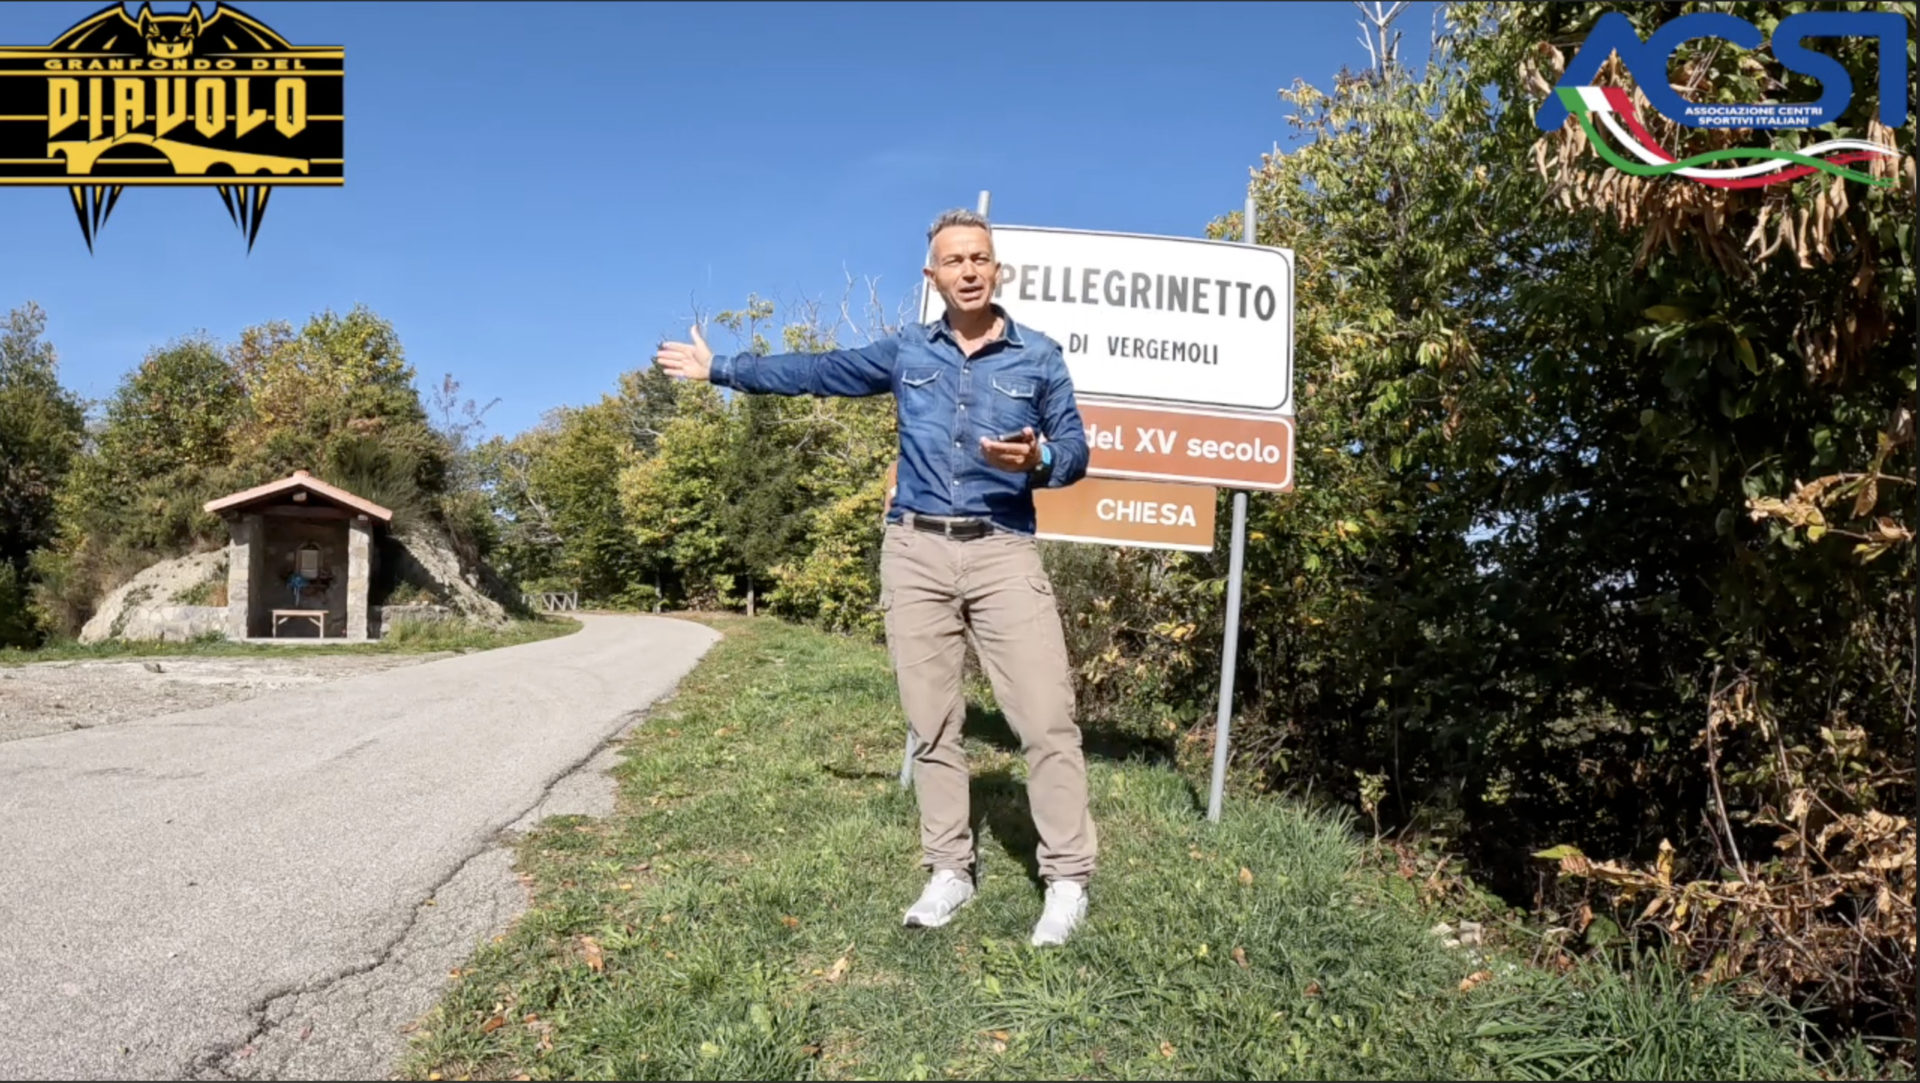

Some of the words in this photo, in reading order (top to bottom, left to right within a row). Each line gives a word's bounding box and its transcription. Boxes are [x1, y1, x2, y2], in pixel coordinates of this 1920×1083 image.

[994, 262, 1276, 322] PELLEGRINETTO
[1068, 332, 1089, 355] DI
[1107, 335, 1219, 366] VERGEMOLI
[1084, 423, 1124, 451] del
[1134, 427, 1178, 455] XV
[1186, 436, 1281, 464] secolo
[1096, 498, 1197, 527] CHIESA
